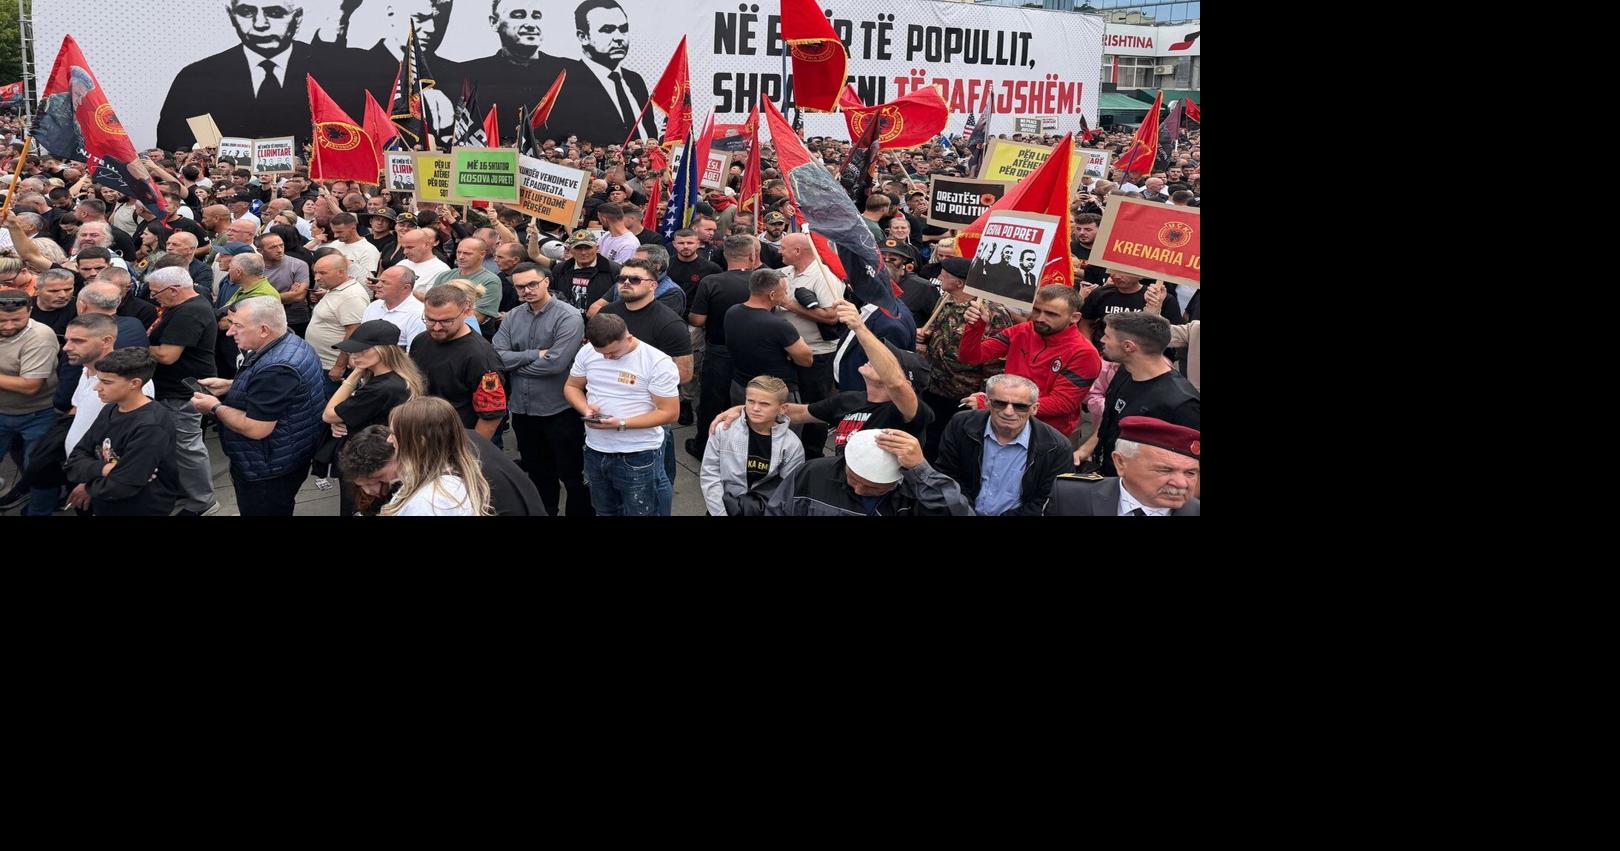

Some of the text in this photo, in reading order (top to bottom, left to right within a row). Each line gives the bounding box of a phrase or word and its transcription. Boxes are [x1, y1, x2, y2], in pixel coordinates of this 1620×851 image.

[713, 3, 1036, 70] NË ER TË POPULLIT,
[1018, 149, 1035, 160] PËR
[1012, 158, 1042, 170] ATËHE
[999, 165, 1017, 176] PËR
[460, 174, 490, 183] KOSOVA
[523, 177, 530, 187] TË
[541, 172, 578, 189] VENDIMEVE
[532, 191, 567, 209] LUFTOJMË
[936, 190, 980, 205] DREJTËSI
[935, 202, 946, 213] JO
[1013, 227, 1038, 242] PRET
[1112, 239, 1184, 266] KRENARIA
[1105, 305, 1130, 314] LIRIA
